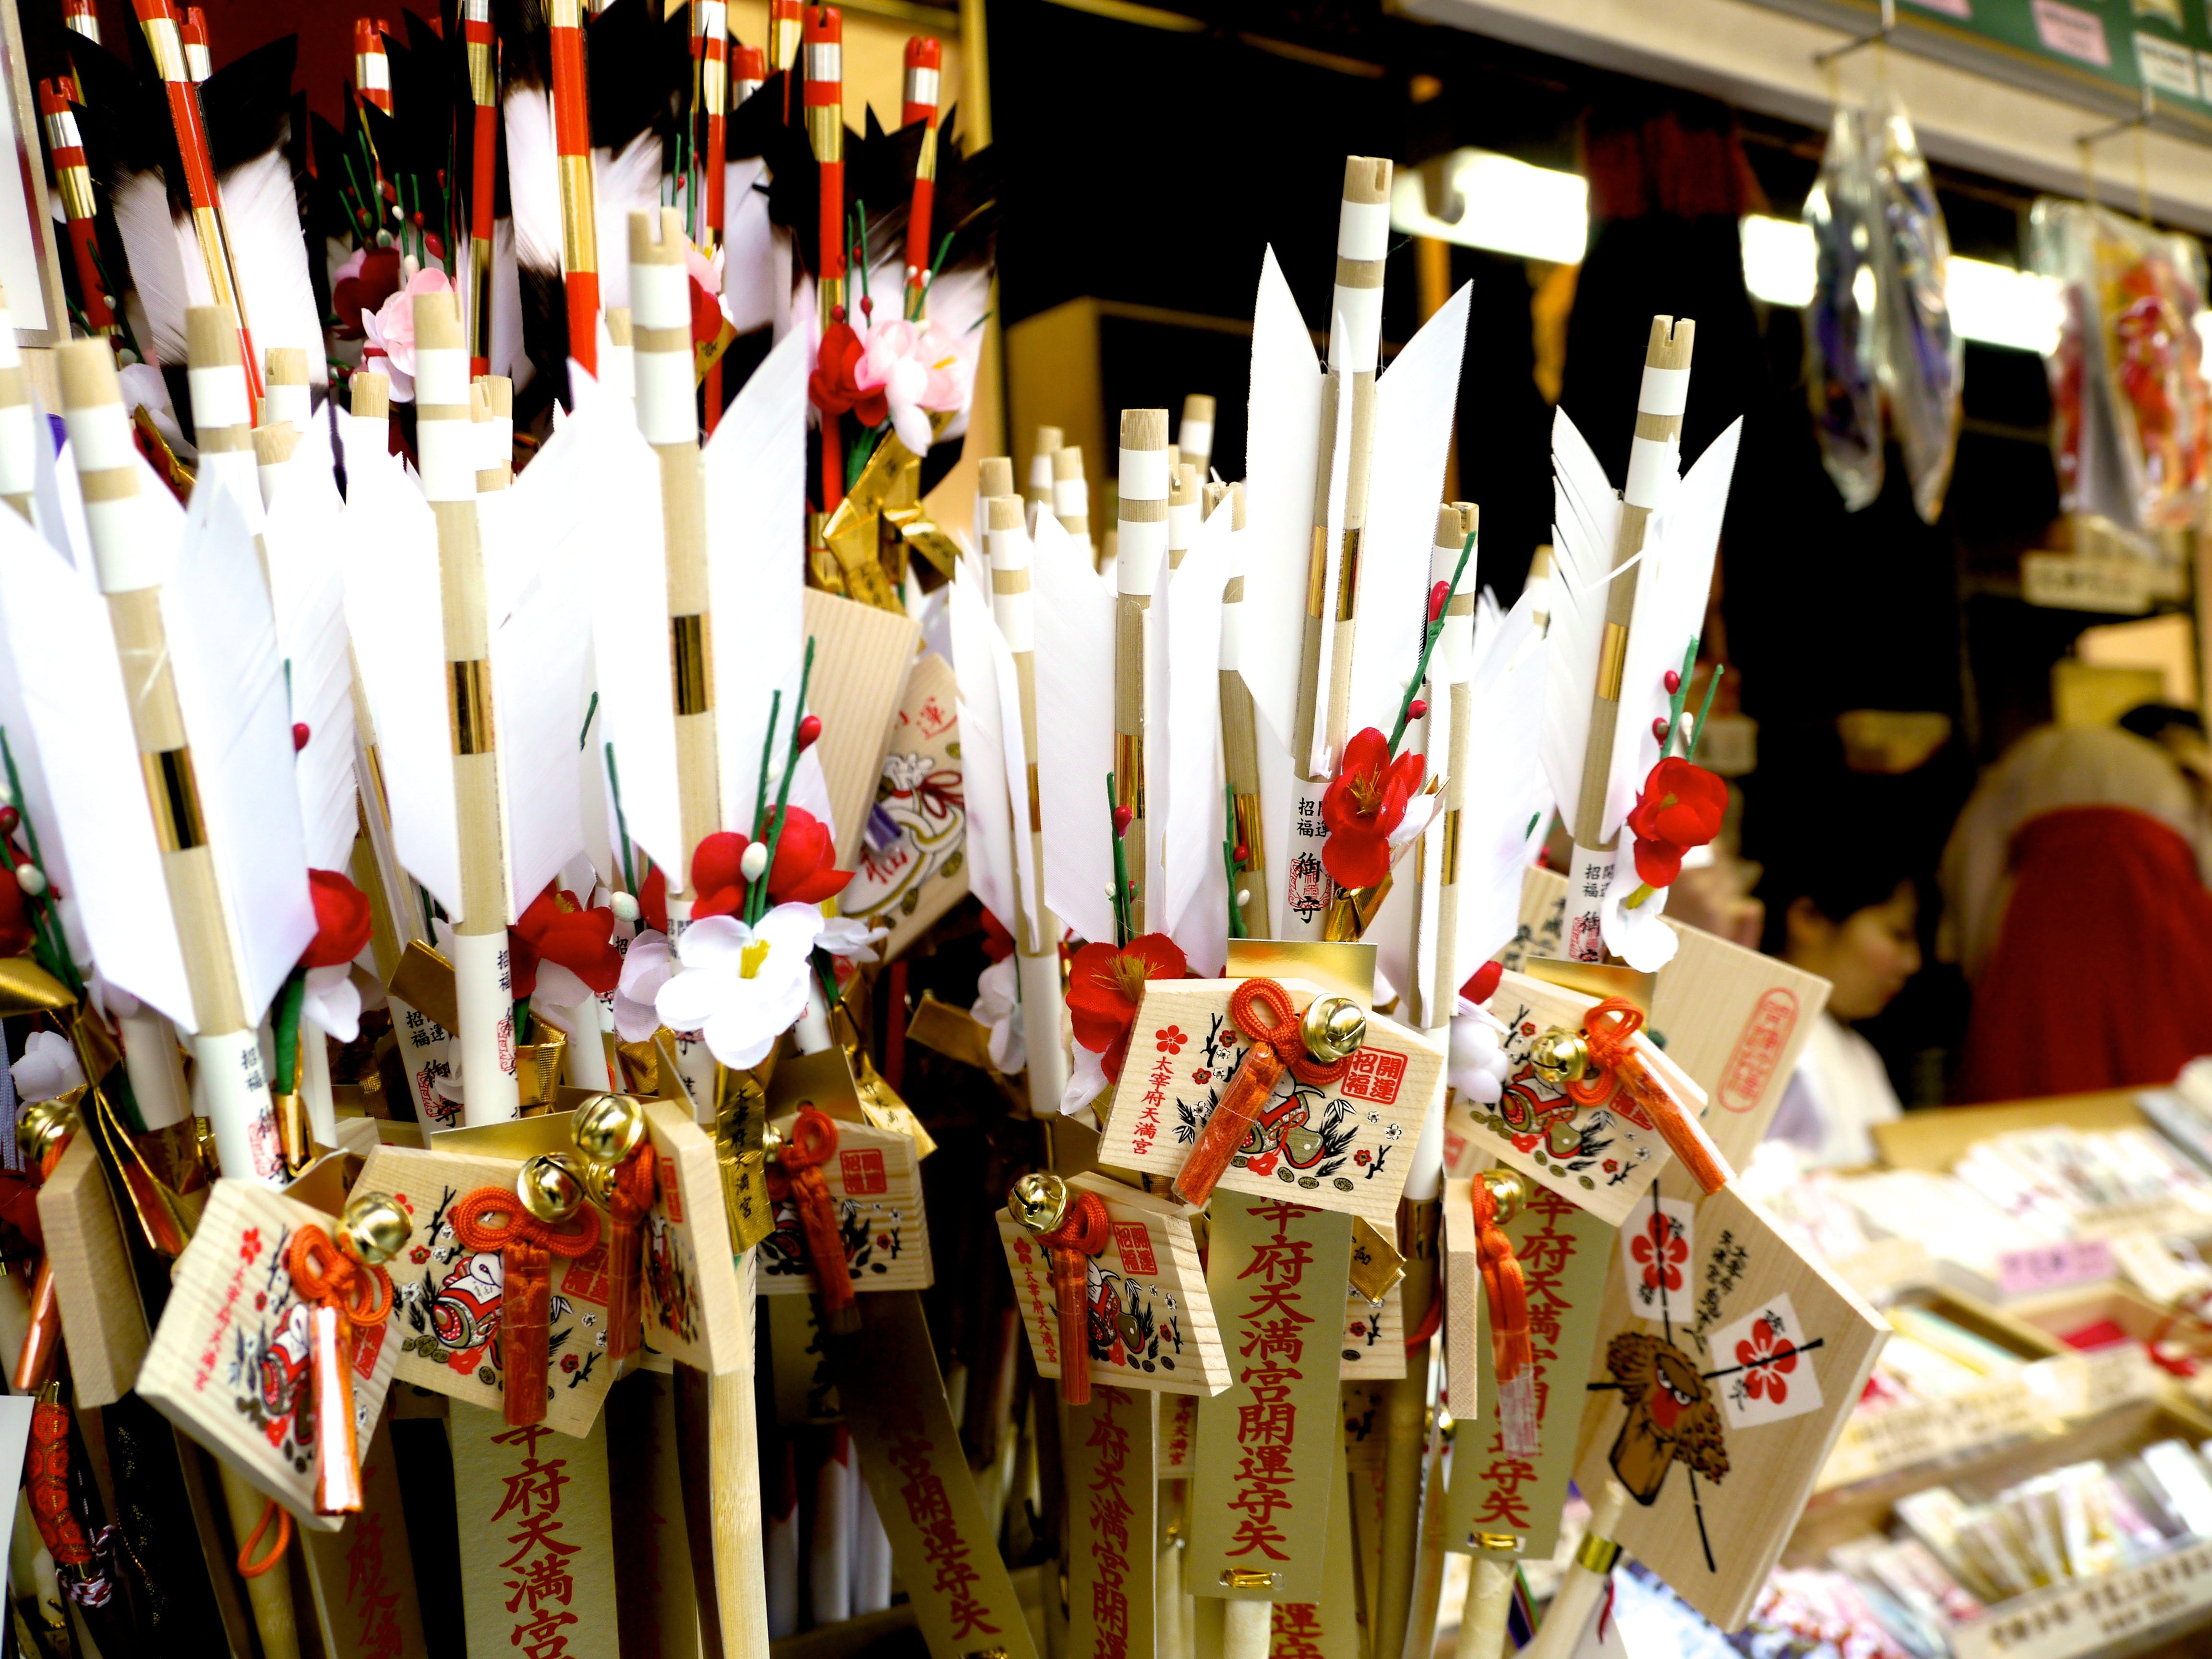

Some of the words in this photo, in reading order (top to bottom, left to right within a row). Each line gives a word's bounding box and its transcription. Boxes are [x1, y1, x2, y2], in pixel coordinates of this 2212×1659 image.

[1297, 797, 1315, 838] 招福
[1293, 852, 1321, 924] 御守
[1583, 864, 1601, 898] 招福
[406, 1010, 430, 1048] 招福
[1346, 1049, 1378, 1095] 招福
[1370, 1055, 1402, 1101] 開運
[1132, 1056, 1175, 1155] 太宰府天満宮
[1025, 1267, 1057, 1363] 太宰府天満宮
